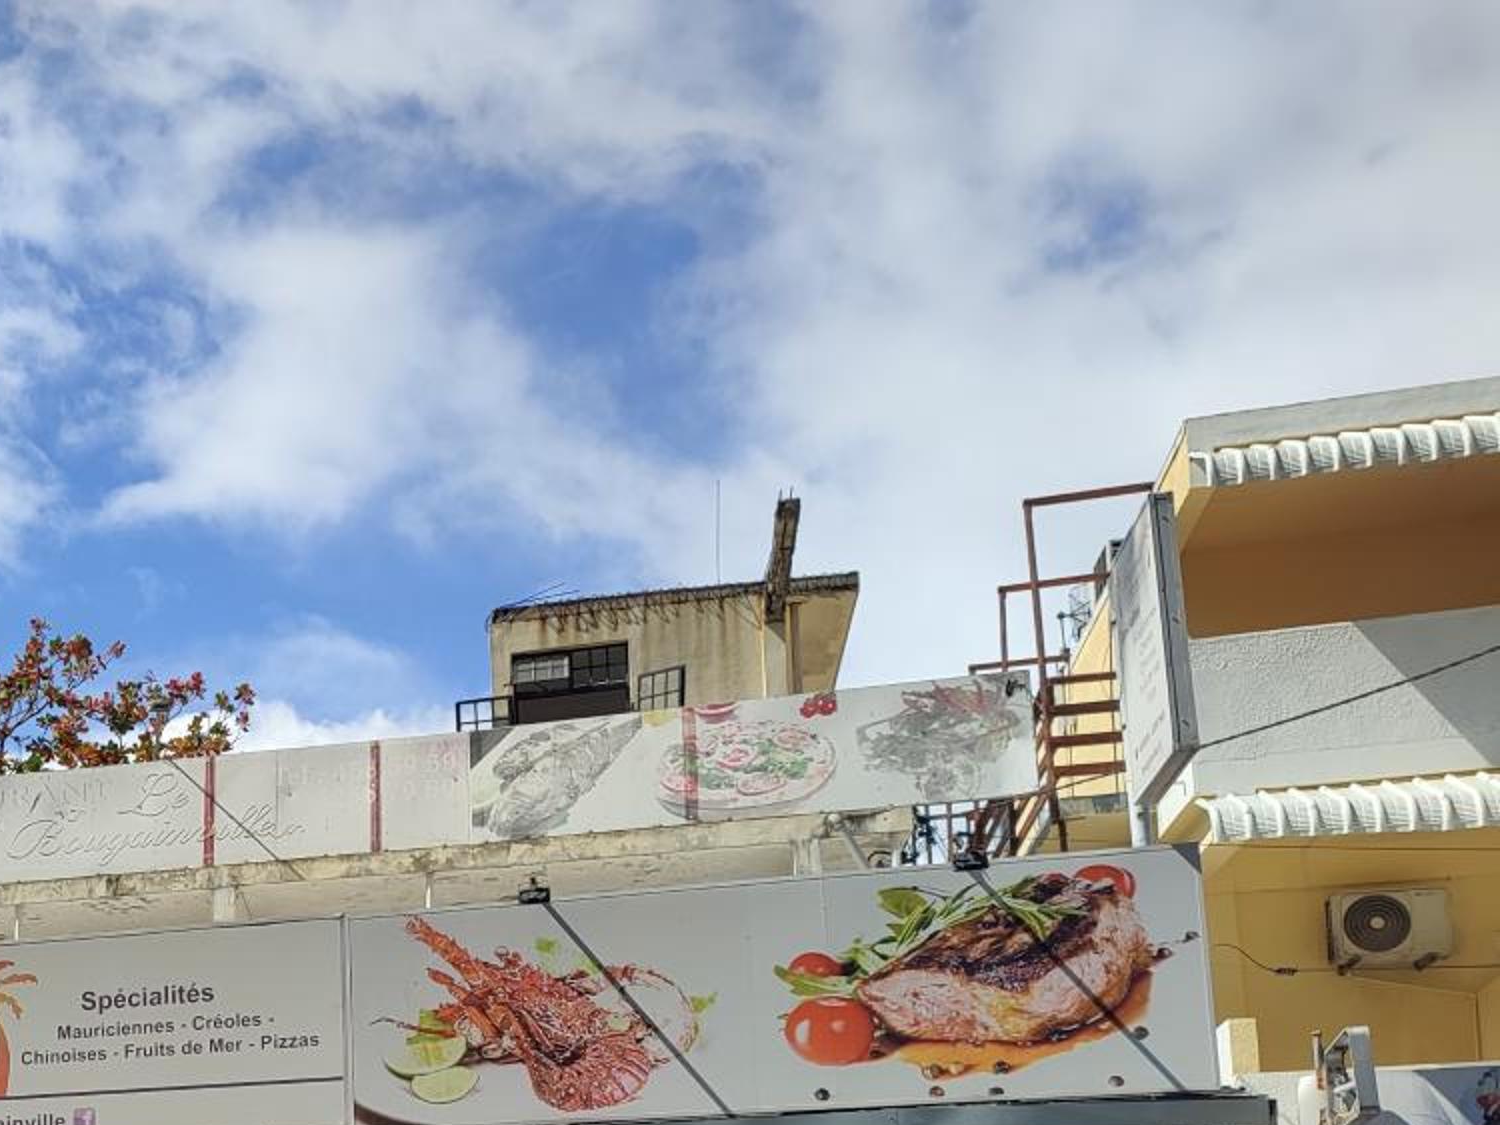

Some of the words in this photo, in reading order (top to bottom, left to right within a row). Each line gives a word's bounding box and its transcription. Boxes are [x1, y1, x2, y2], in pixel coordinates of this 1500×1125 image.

[81, 982, 215, 1015] Spécialités
[57, 1017, 175, 1041] Mauriciennes
[192, 1013, 262, 1032] Créoles
[21, 1047, 108, 1067] Chinoises
[124, 1039, 176, 1060] Fruits
[181, 1037, 203, 1055] de
[208, 1036, 243, 1054] Mer
[261, 1032, 320, 1051] Pizzas
